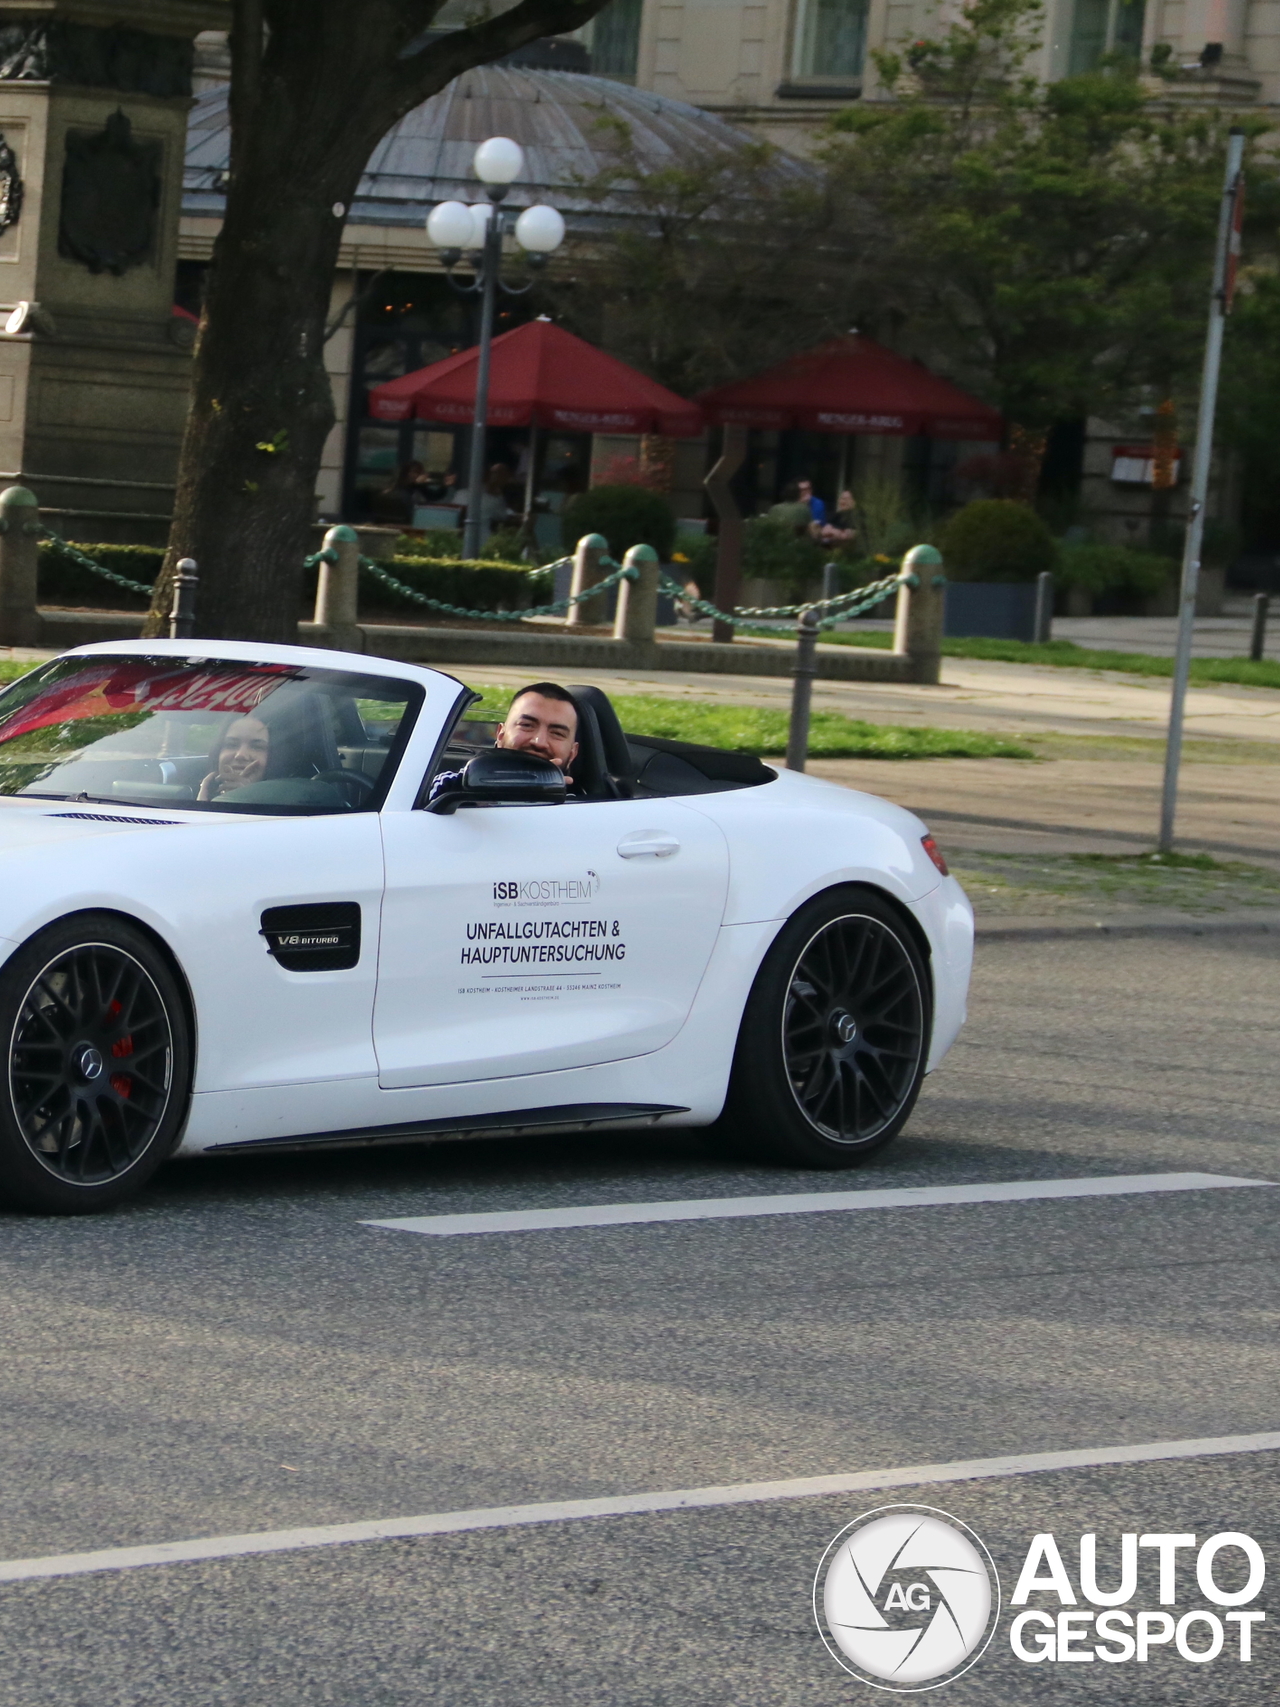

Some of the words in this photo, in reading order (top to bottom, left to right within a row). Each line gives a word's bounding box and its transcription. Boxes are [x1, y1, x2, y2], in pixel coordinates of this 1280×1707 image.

[277, 935, 300, 945] V8
[301, 936, 339, 945] BITURBO
[466, 920, 607, 940] UNFALLGUTACHTEN
[611, 920, 620, 937] &
[461, 943, 626, 964] HAUPTUNTERSUCHUNG
